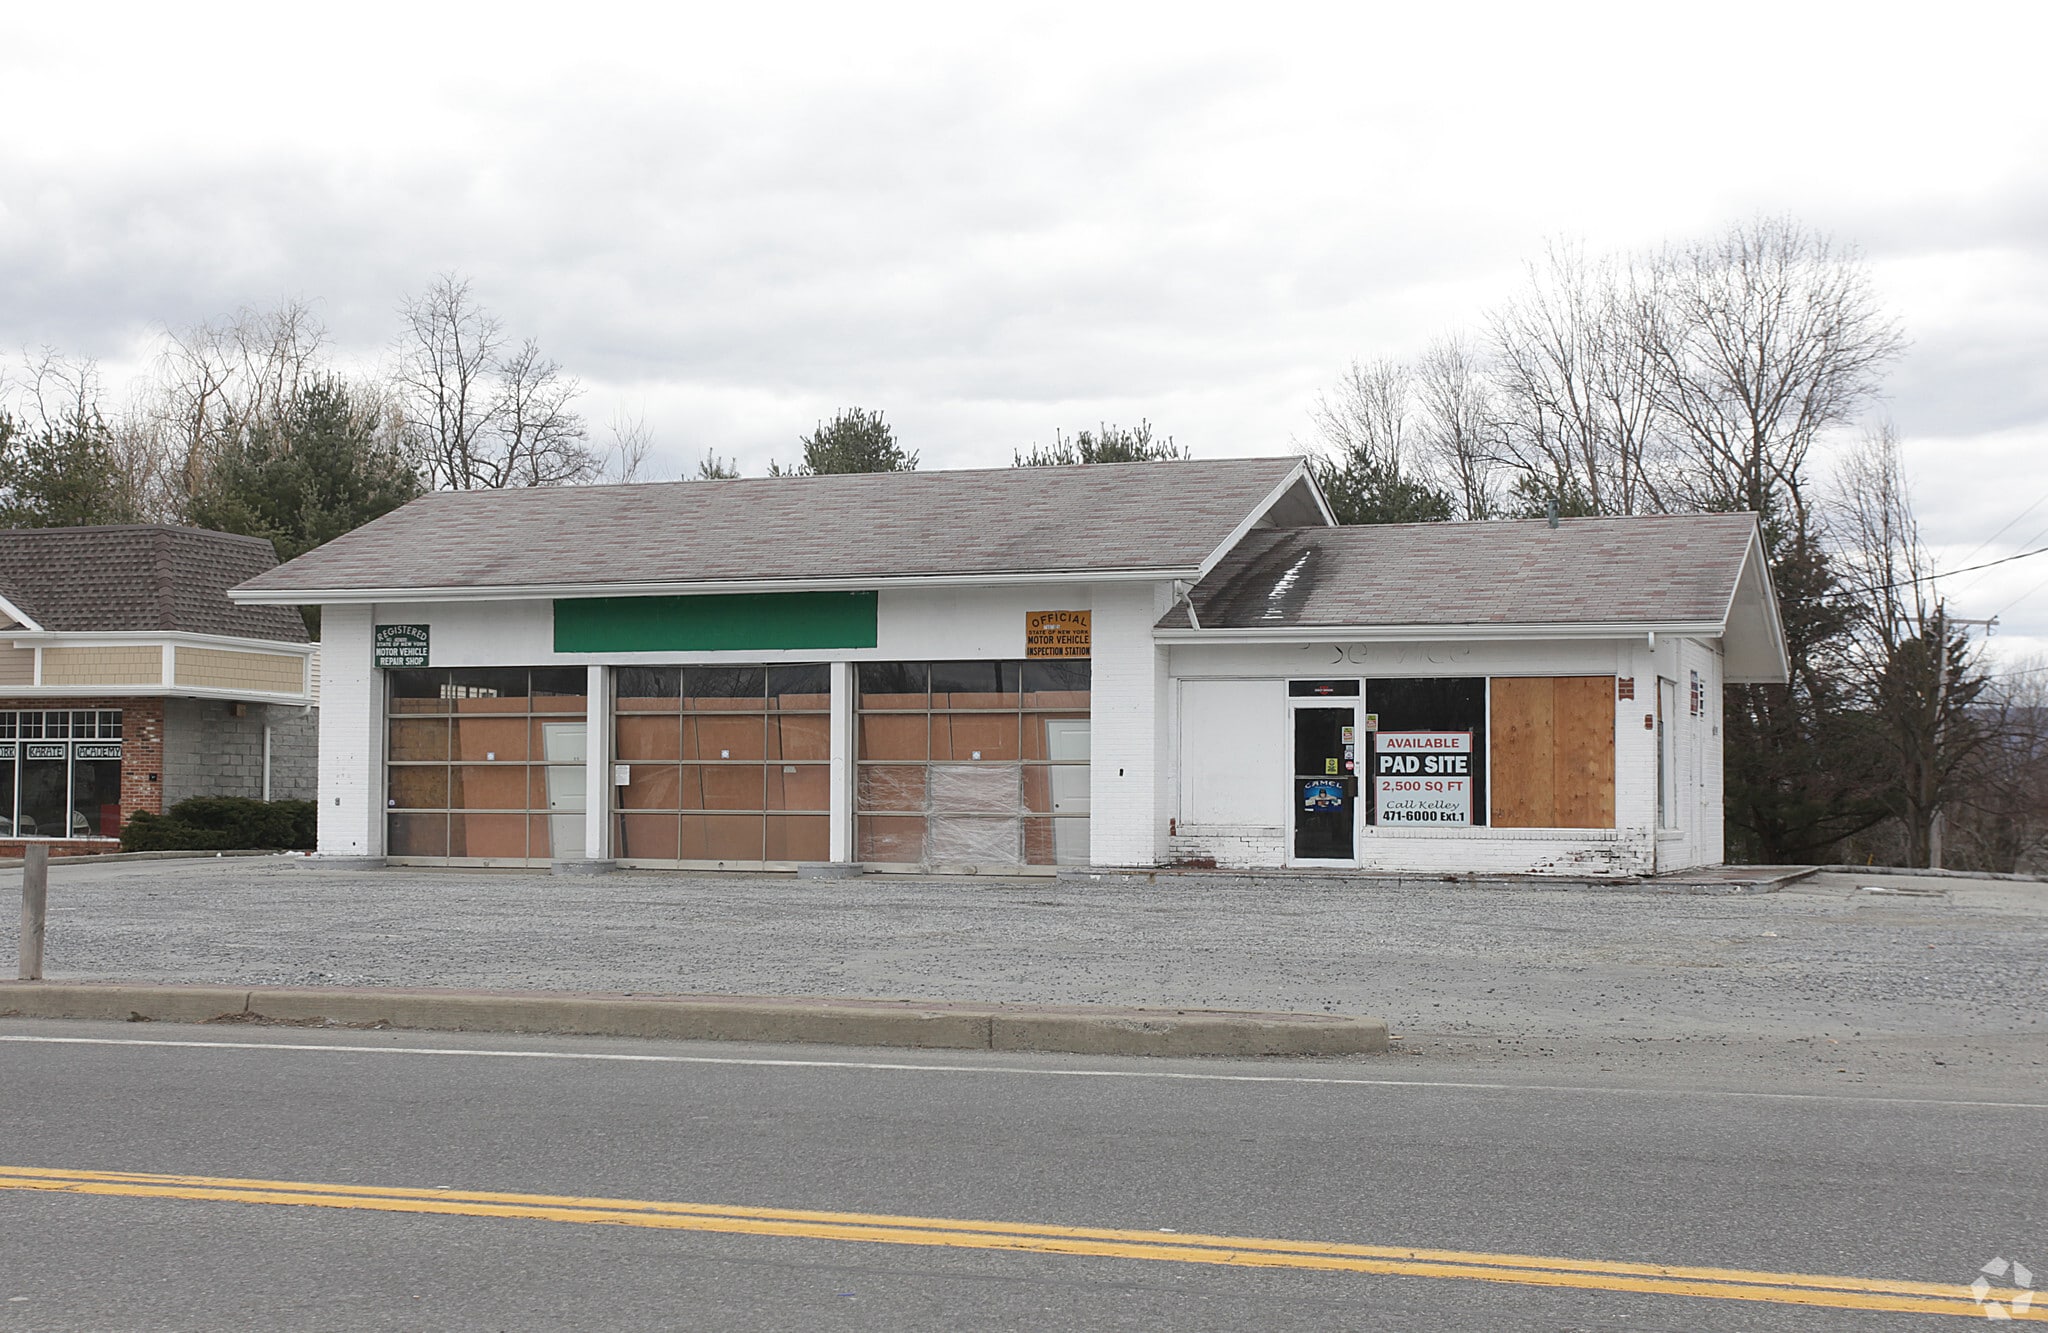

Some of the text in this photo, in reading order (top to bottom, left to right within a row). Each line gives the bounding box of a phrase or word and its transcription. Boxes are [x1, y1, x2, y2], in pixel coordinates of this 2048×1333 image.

[1032, 612, 1087, 627] OFFICIAL
[377, 626, 428, 641] REGISTERED
[1028, 635, 1089, 644] MOTOR VEHICLE
[376, 648, 428, 656] MOTOR VEHICLE
[1027, 647, 1090, 656] INSPECTION STATION
[380, 657, 424, 665] REPAIR SHOP
[1386, 738, 1460, 749] AVAILABLE
[0, 746, 121, 757] RK KARATE ACADEMY
[1380, 755, 1468, 774] PAD SITE
[1304, 780, 1342, 789] CAMEL
[1382, 781, 1463, 792] 2,500 SQ FT
[1386, 800, 1460, 811] Call Kelley
[1382, 811, 1465, 822] 471-6000 Ext.1
